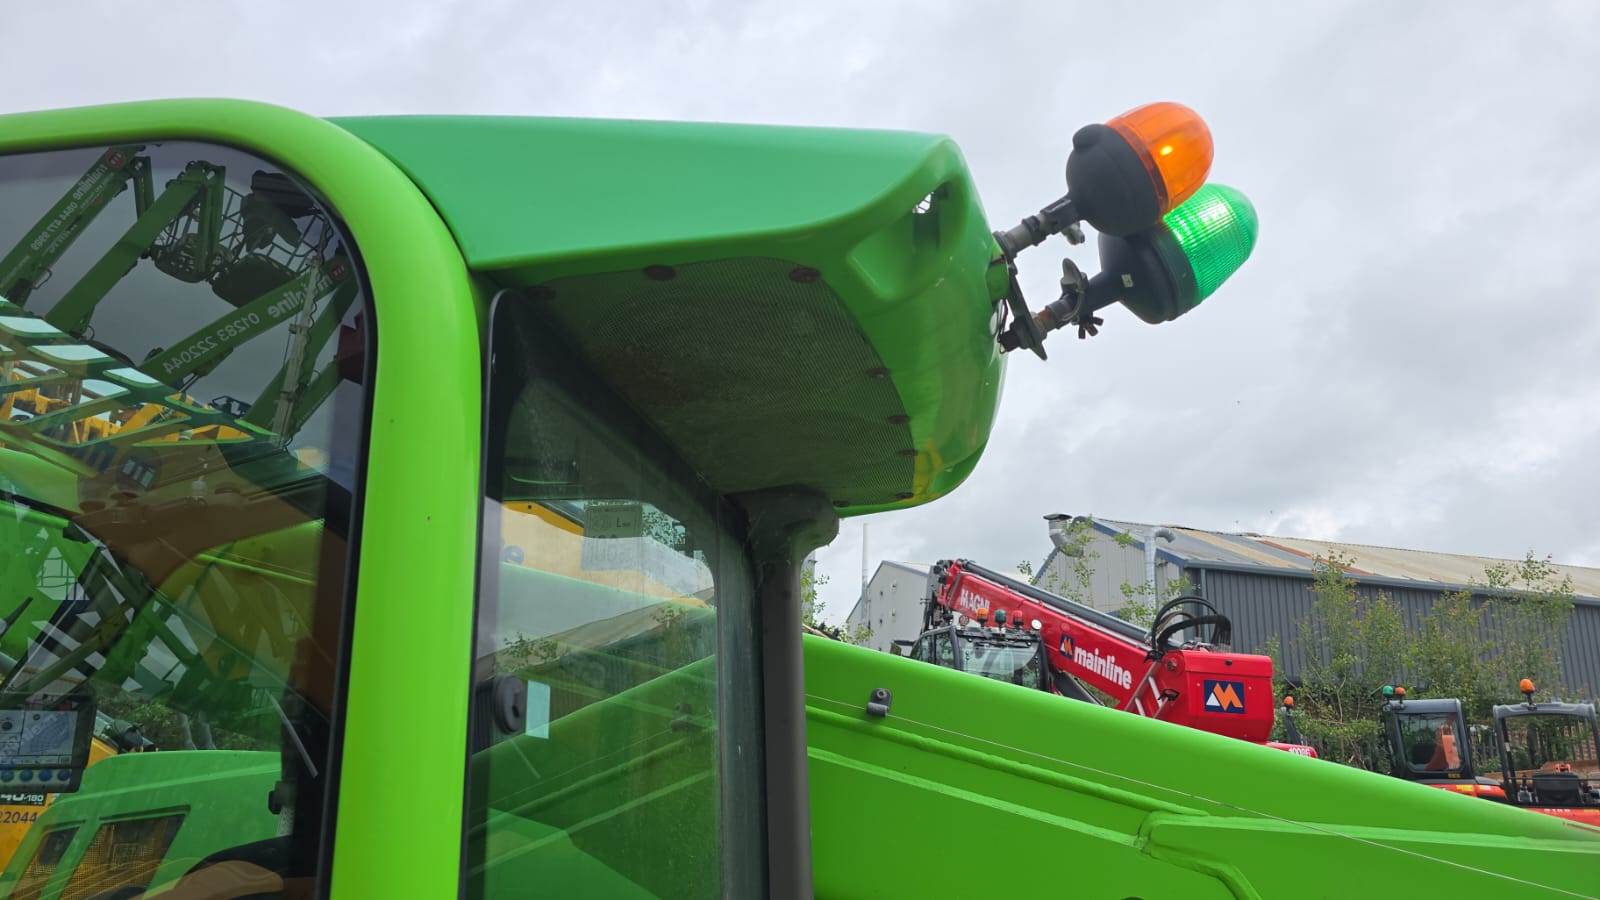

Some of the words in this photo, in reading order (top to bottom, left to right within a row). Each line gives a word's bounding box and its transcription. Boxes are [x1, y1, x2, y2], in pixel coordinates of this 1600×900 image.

[960, 588, 990, 613] MAGNI
[1073, 646, 1132, 690] mainline
[0, 811, 38, 824] 2044
